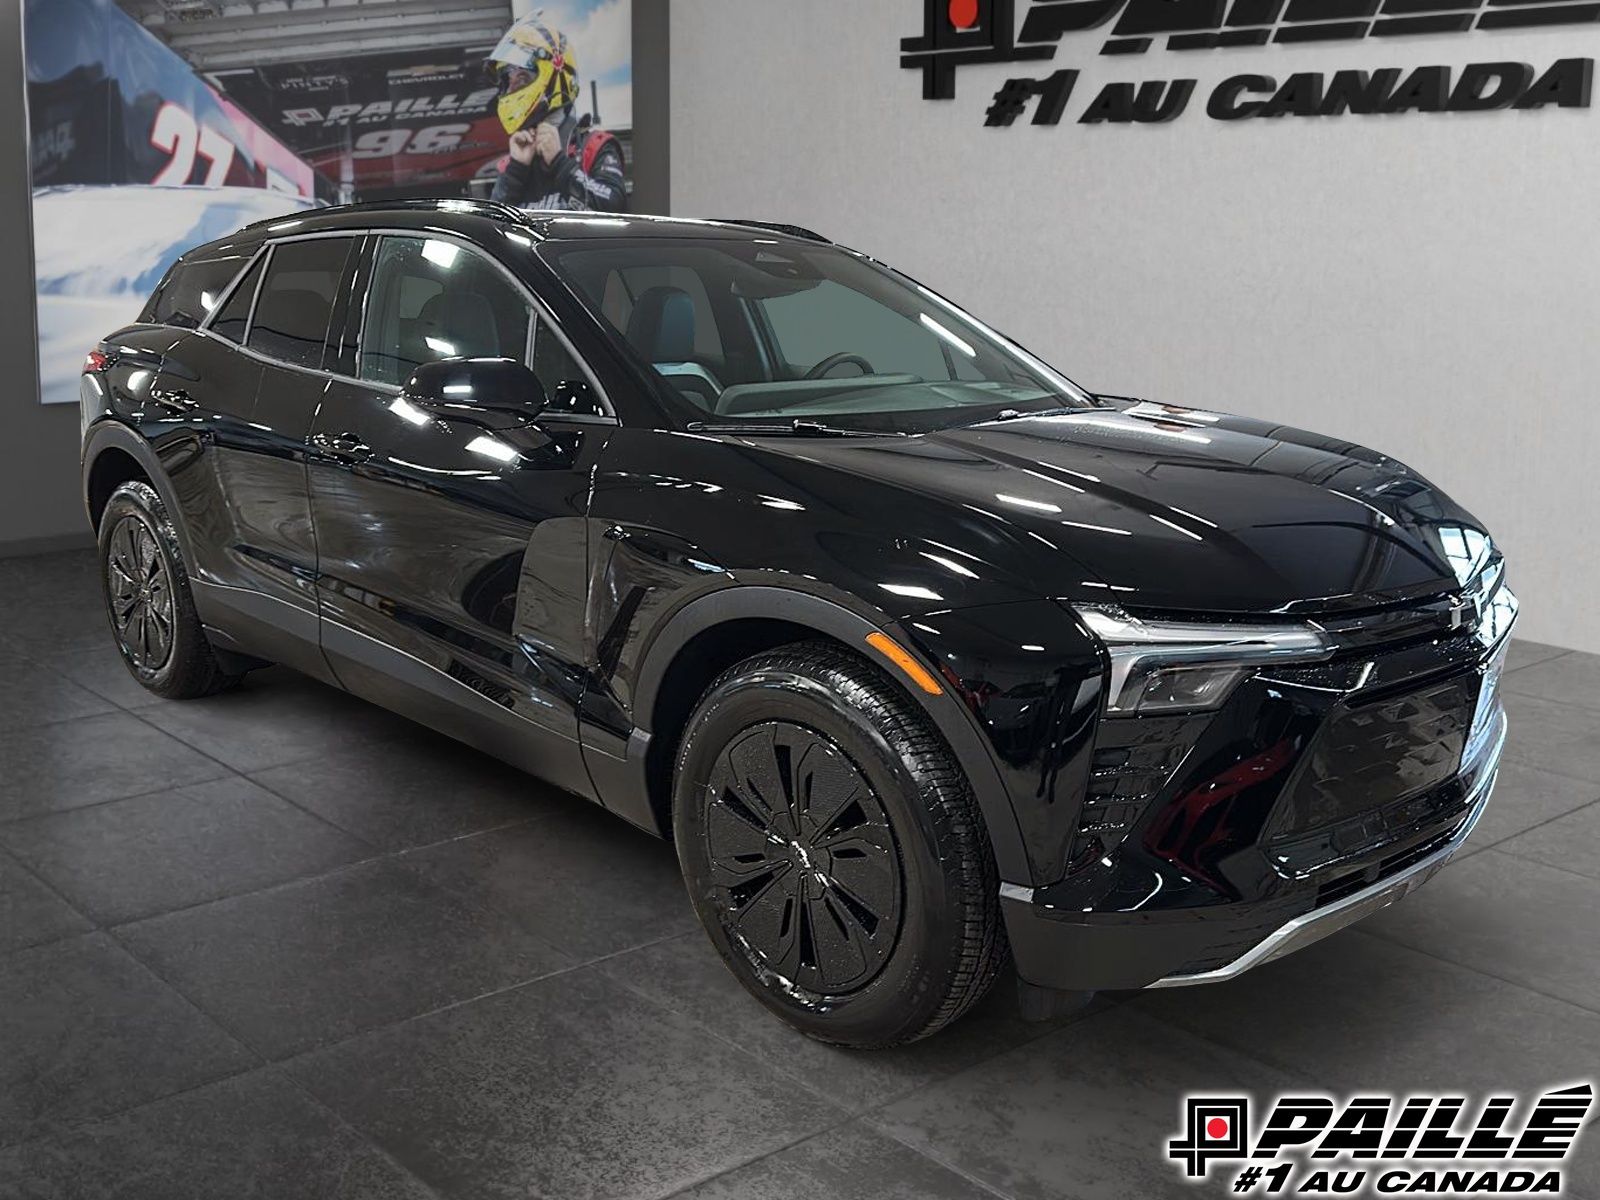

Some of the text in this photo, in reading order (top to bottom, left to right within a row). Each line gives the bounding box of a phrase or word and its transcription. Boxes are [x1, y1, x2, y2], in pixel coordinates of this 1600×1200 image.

[388, 73, 464, 85] CHEVROLET
[984, 58, 1594, 126] #1 AU CANADA
[394, 105, 488, 121] CANADA
[352, 123, 471, 159] 96
